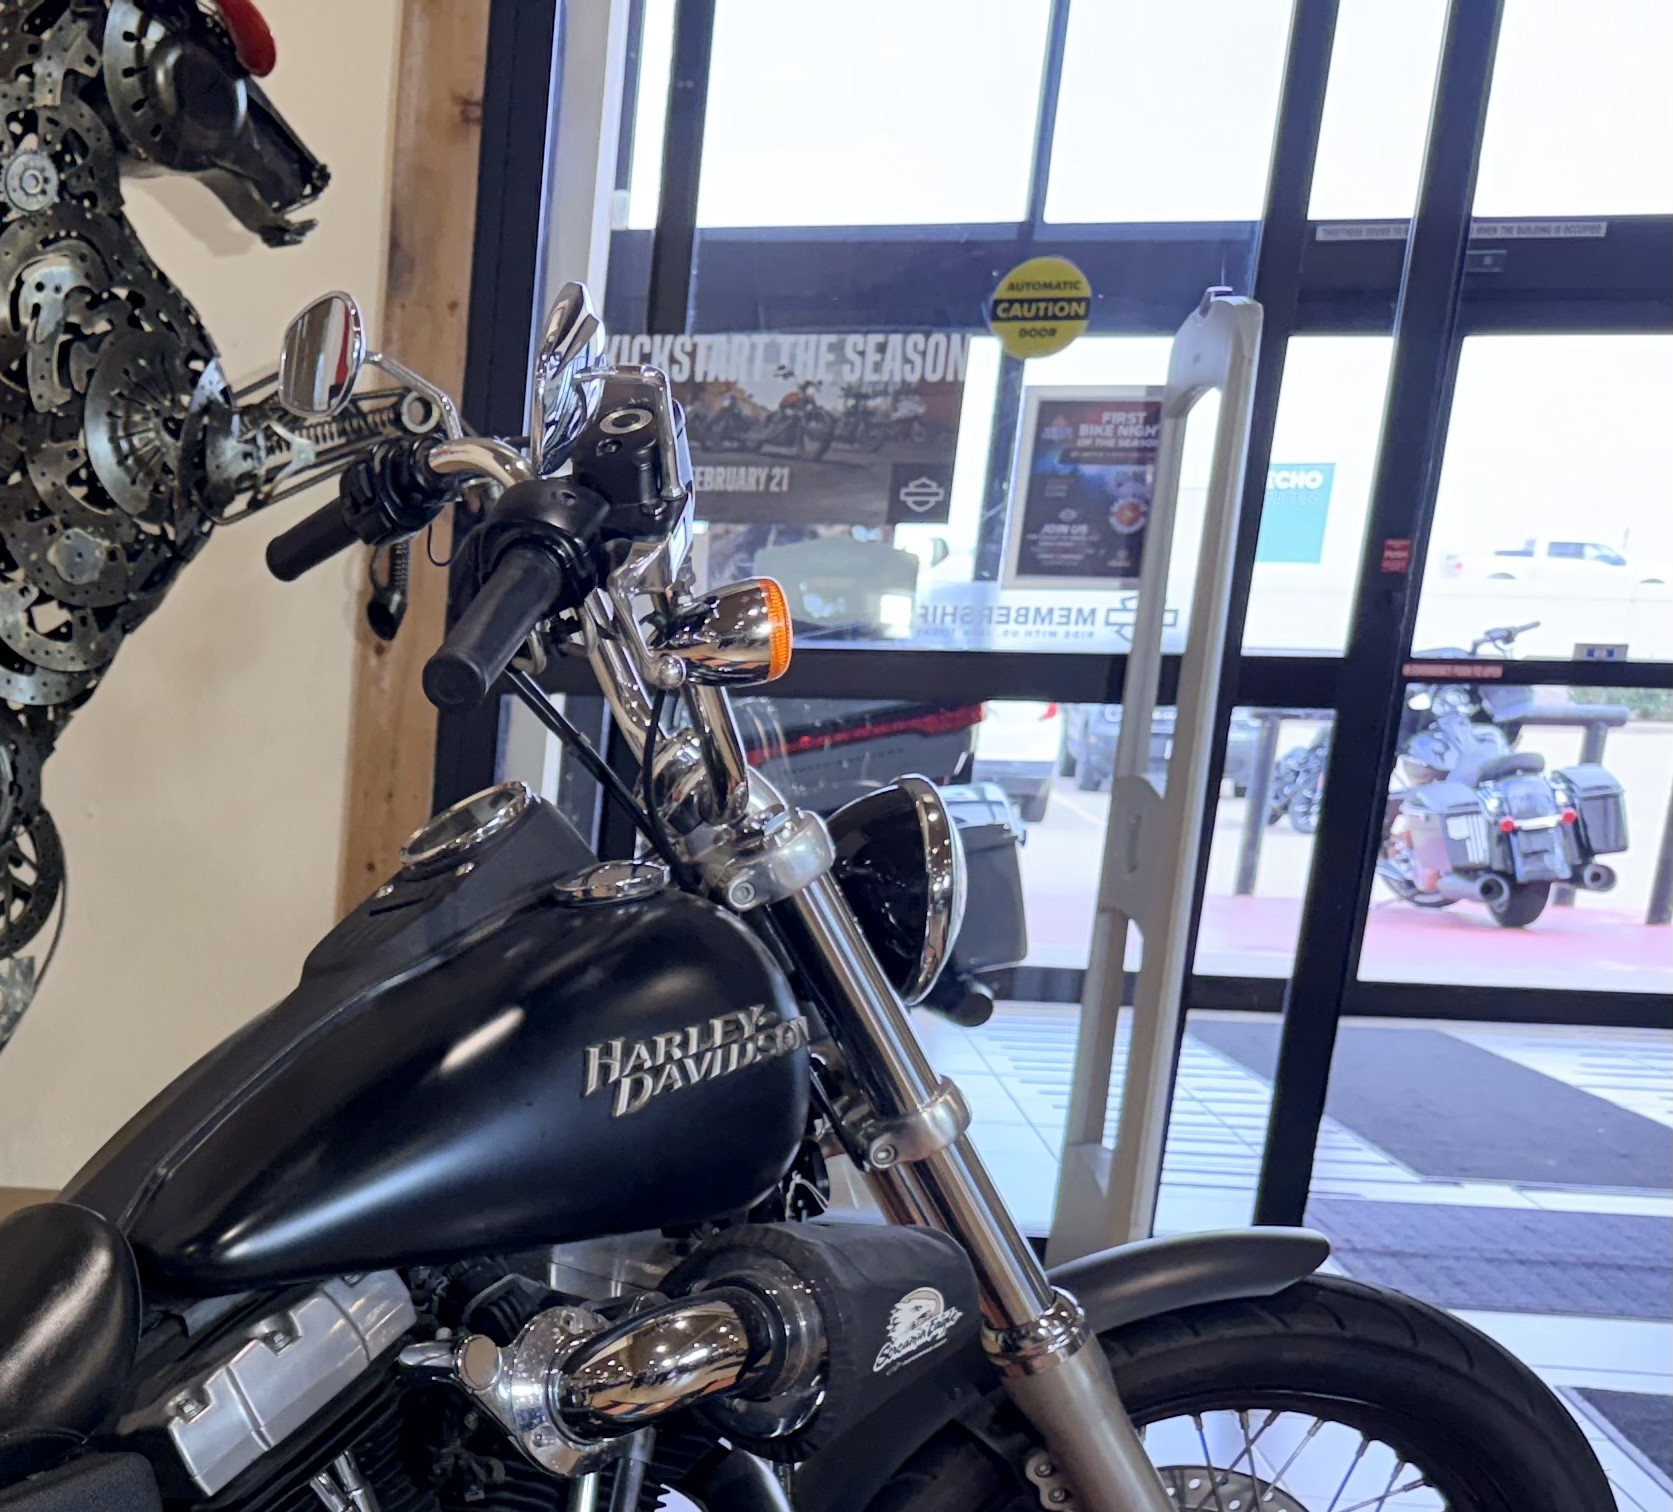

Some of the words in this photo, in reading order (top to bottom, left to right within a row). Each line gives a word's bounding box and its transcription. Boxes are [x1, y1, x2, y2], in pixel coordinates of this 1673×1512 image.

[1007, 281, 1081, 291] AUTOMATIC
[996, 301, 1086, 318] CAUTION
[1018, 328, 1057, 338] DOOR
[774, 333, 837, 383] THE
[841, 333, 973, 383] SEASON
[1102, 411, 1146, 425] FIRST
[1079, 424, 1114, 437] BIKE
[694, 465, 769, 491] EBRUARY
[770, 466, 790, 491] 21
[609, 1014, 810, 1119] DAVIDSON
